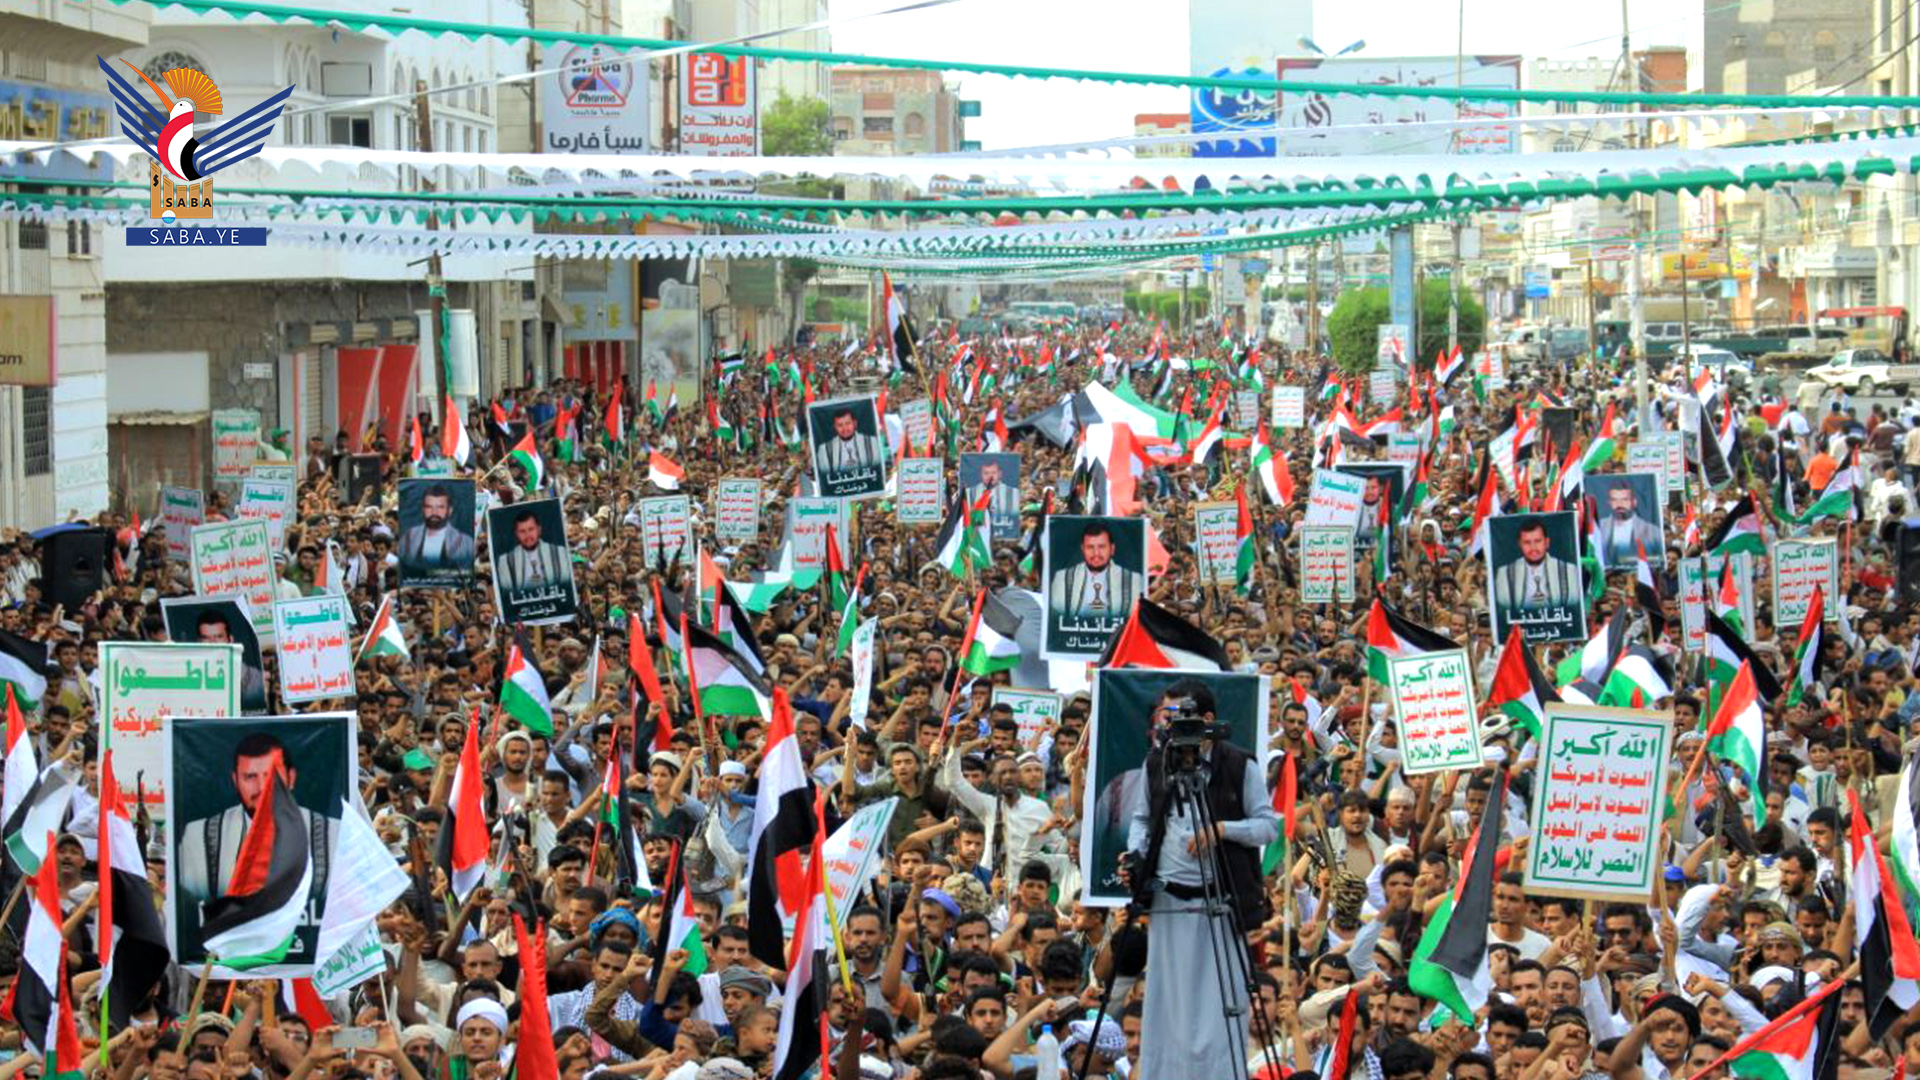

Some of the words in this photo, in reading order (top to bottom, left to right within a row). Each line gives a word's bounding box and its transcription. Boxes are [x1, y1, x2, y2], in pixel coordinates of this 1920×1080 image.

[549, 131, 600, 154] فارما
[604, 125, 643, 154] سبأ
[1506, 607, 1573, 627] ياقائدنا
[1066, 635, 1107, 652] وضناك
[1521, 626, 1560, 641] فوضنا
[114, 659, 225, 697] قاطعوا
[1438, 660, 1462, 678] الله
[1553, 726, 1618, 762] أكبر
[1617, 732, 1657, 759] الله
[1609, 770, 1653, 789] الموت
[1605, 799, 1650, 817] الموت
[1543, 820, 1583, 842] اليهود
[1586, 822, 1608, 843] على
[1611, 822, 1646, 843] اللعنة
[1539, 844, 1593, 876] للإسلام
[1594, 848, 1643, 878] النصر
